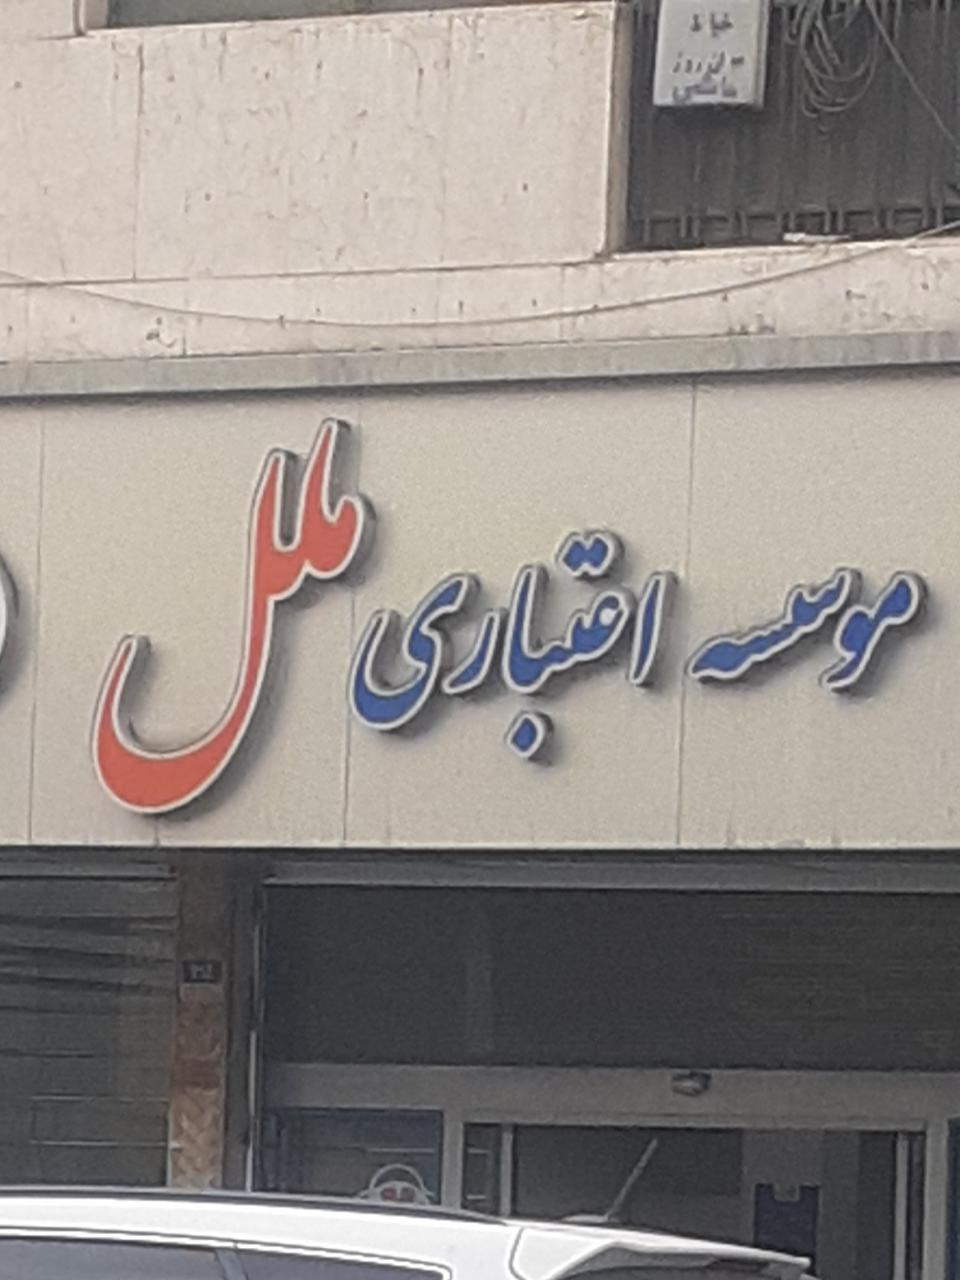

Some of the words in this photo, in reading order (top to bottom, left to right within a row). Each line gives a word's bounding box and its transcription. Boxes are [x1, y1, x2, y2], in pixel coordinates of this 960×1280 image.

[93, 418, 366, 815] ملل
[350, 529, 668, 759] اعتباری
[690, 568, 921, 692] موسسه
